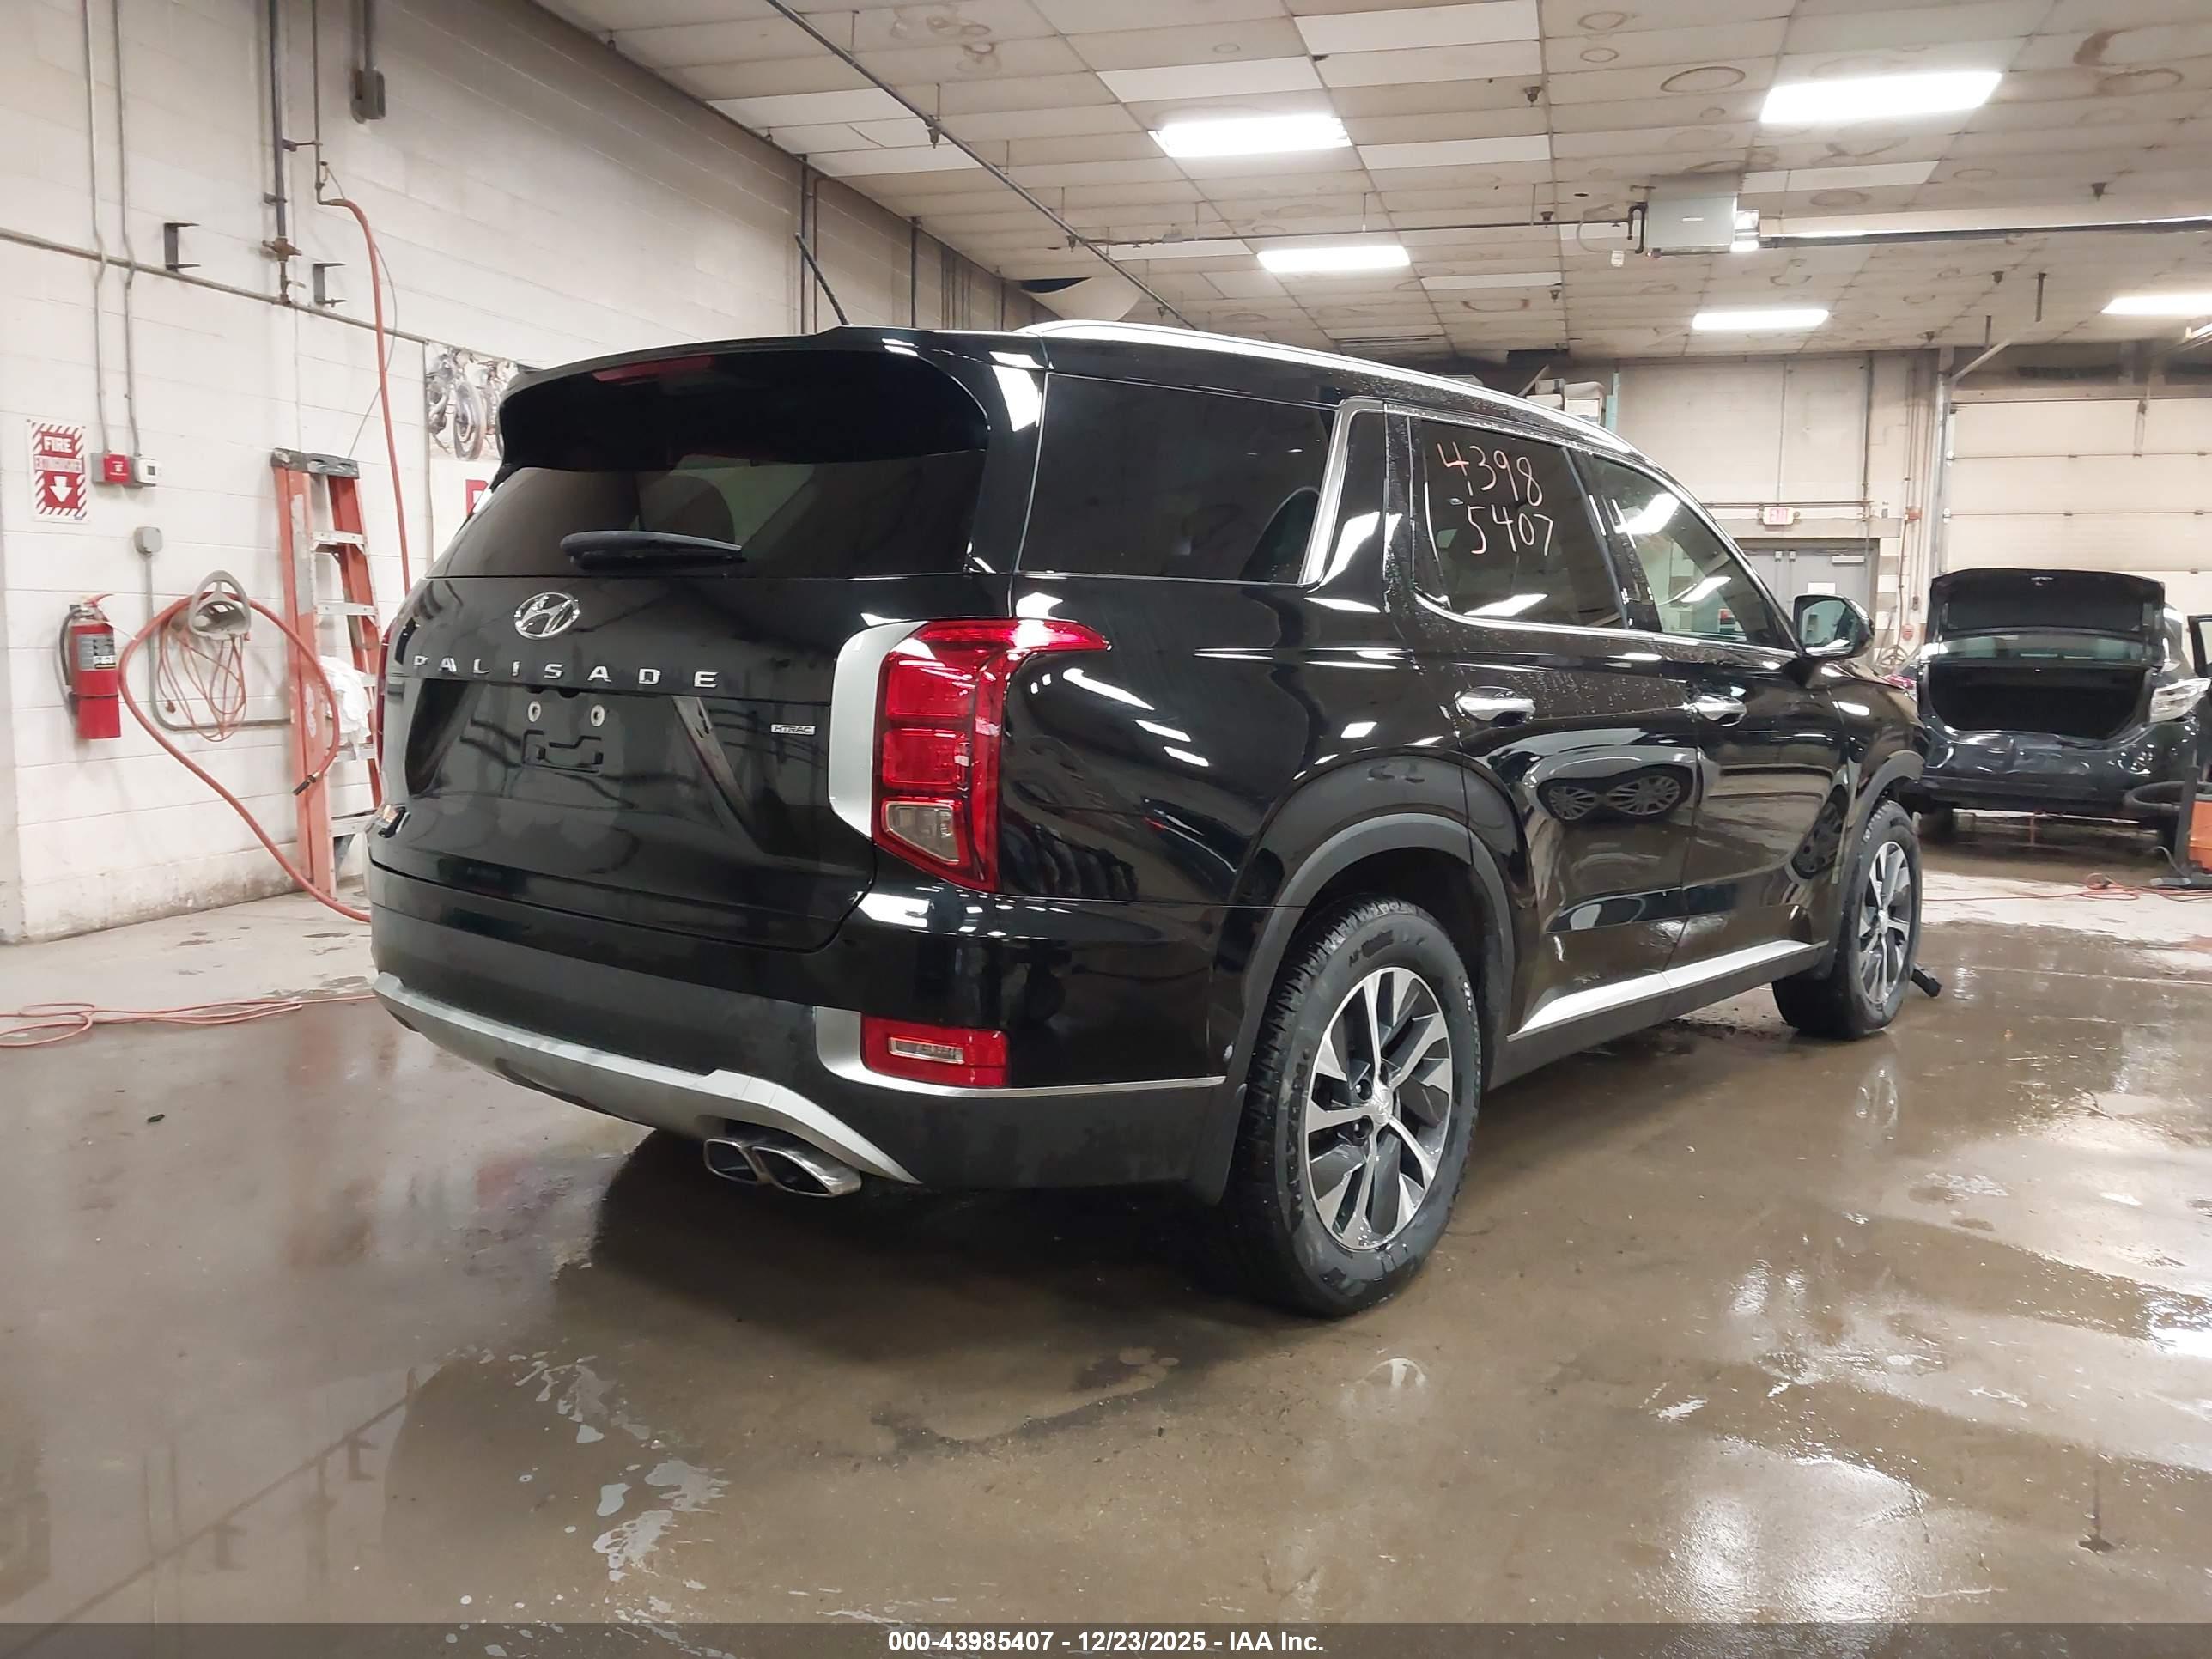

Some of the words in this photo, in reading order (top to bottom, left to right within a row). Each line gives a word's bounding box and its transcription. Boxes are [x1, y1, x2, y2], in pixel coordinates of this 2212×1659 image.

[43, 436, 73, 453] FIRE
[1437, 441, 1543, 507] 4398
[1467, 504, 1554, 557] 5407
[413, 654, 719, 688] PALISADE
[773, 725, 813, 734] HTRAC
